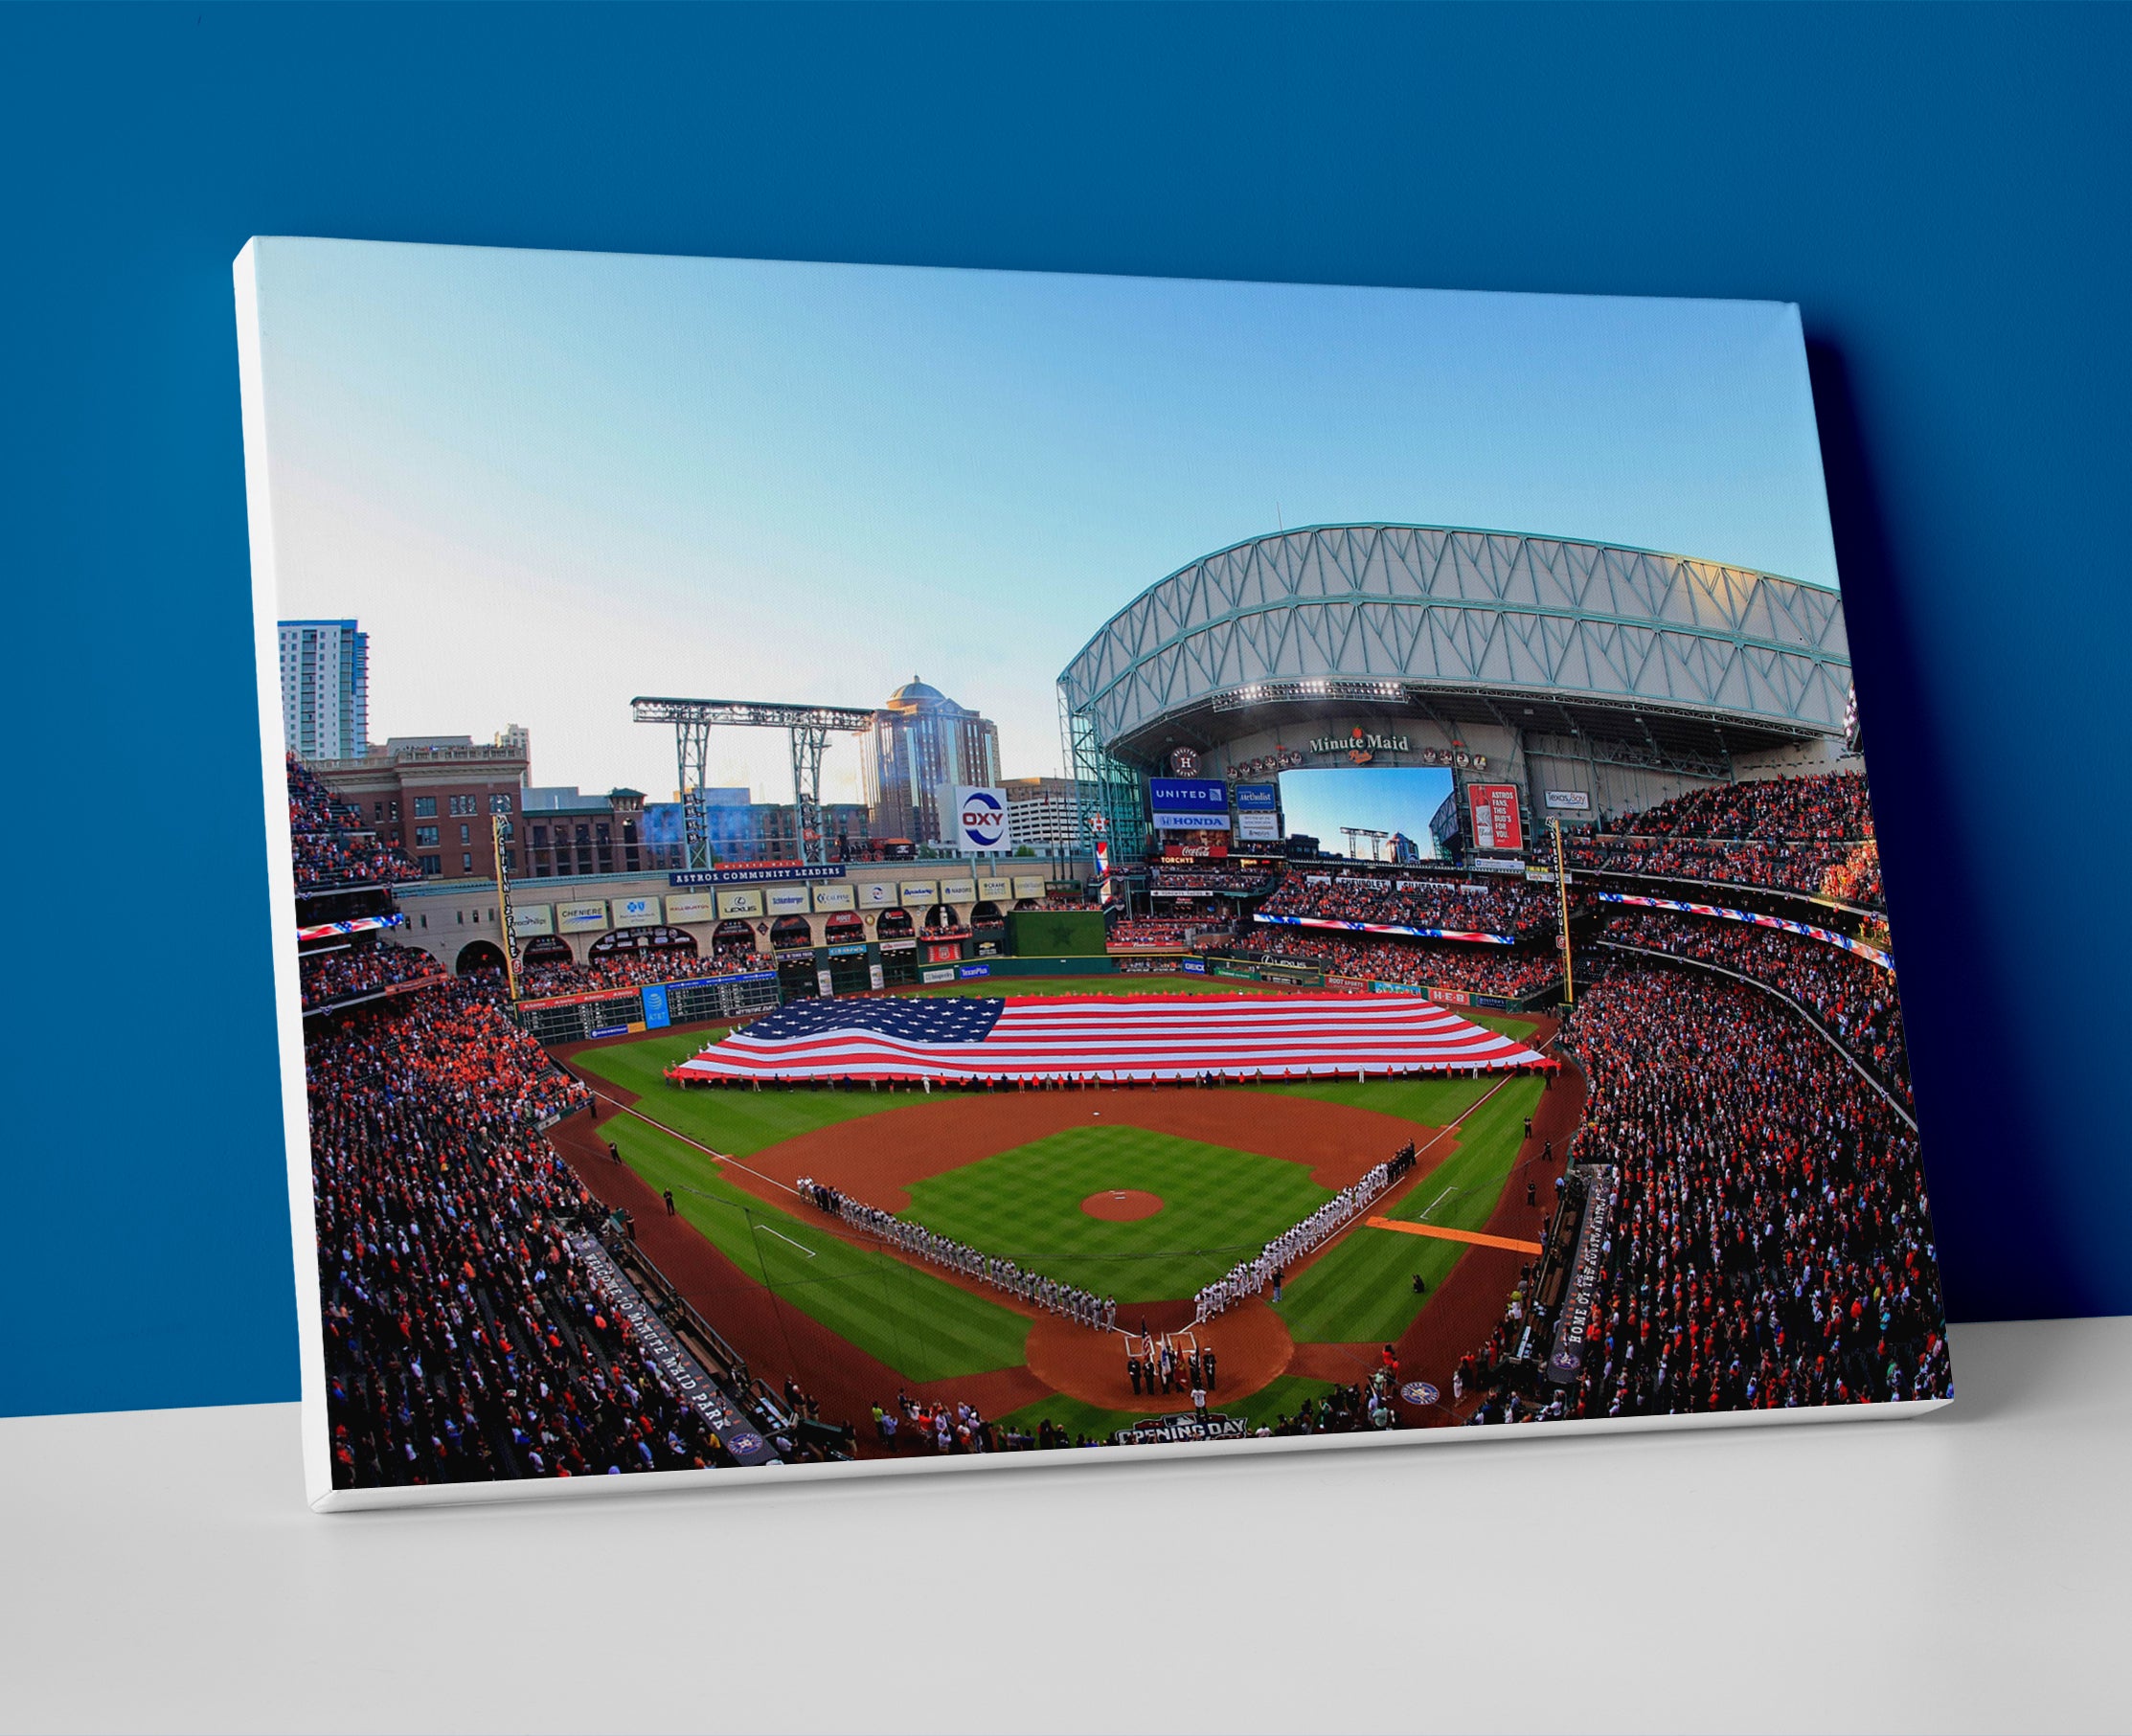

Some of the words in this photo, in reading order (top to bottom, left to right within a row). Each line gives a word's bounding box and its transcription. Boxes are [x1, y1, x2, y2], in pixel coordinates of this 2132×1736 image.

[1309, 736, 1364, 753] Minute
[1366, 733, 1409, 751] Maid
[1156, 790, 1207, 799] UNITED
[1239, 792, 1271, 801] Methodist
[1491, 791, 1513, 800] ASTROS
[1548, 792, 1568, 802] Texas
[1570, 793, 1586, 804] Bay
[963, 812, 1003, 826] OXY
[1173, 817, 1223, 826] HONDA
[1496, 830, 1509, 839] YOU.
[676, 871, 719, 883] ASTROS
[723, 869, 790, 881] COMMUNITY
[795, 868, 840, 877] LEADERS
[1341, 879, 1386, 889] CHEVROLET
[498, 837, 510, 892] CHIKIN
[507, 917, 518, 957] FARE
[561, 908, 602, 918] CHENIERE
[724, 905, 757, 913] LEXUS
[1274, 959, 1307, 968] LEXUS
[1328, 977, 1345, 985] ROOT
[1345, 980, 1364, 988] SPORTS
[648, 1012, 666, 1021] AT&T
[584, 1253, 623, 1296] WELCOME
[627, 1312, 669, 1355] MINUTE
[662, 1356, 696, 1390] MAID
[1569, 1308, 1587, 1344] HOME
[1208, 1419, 1245, 1435] DAY
